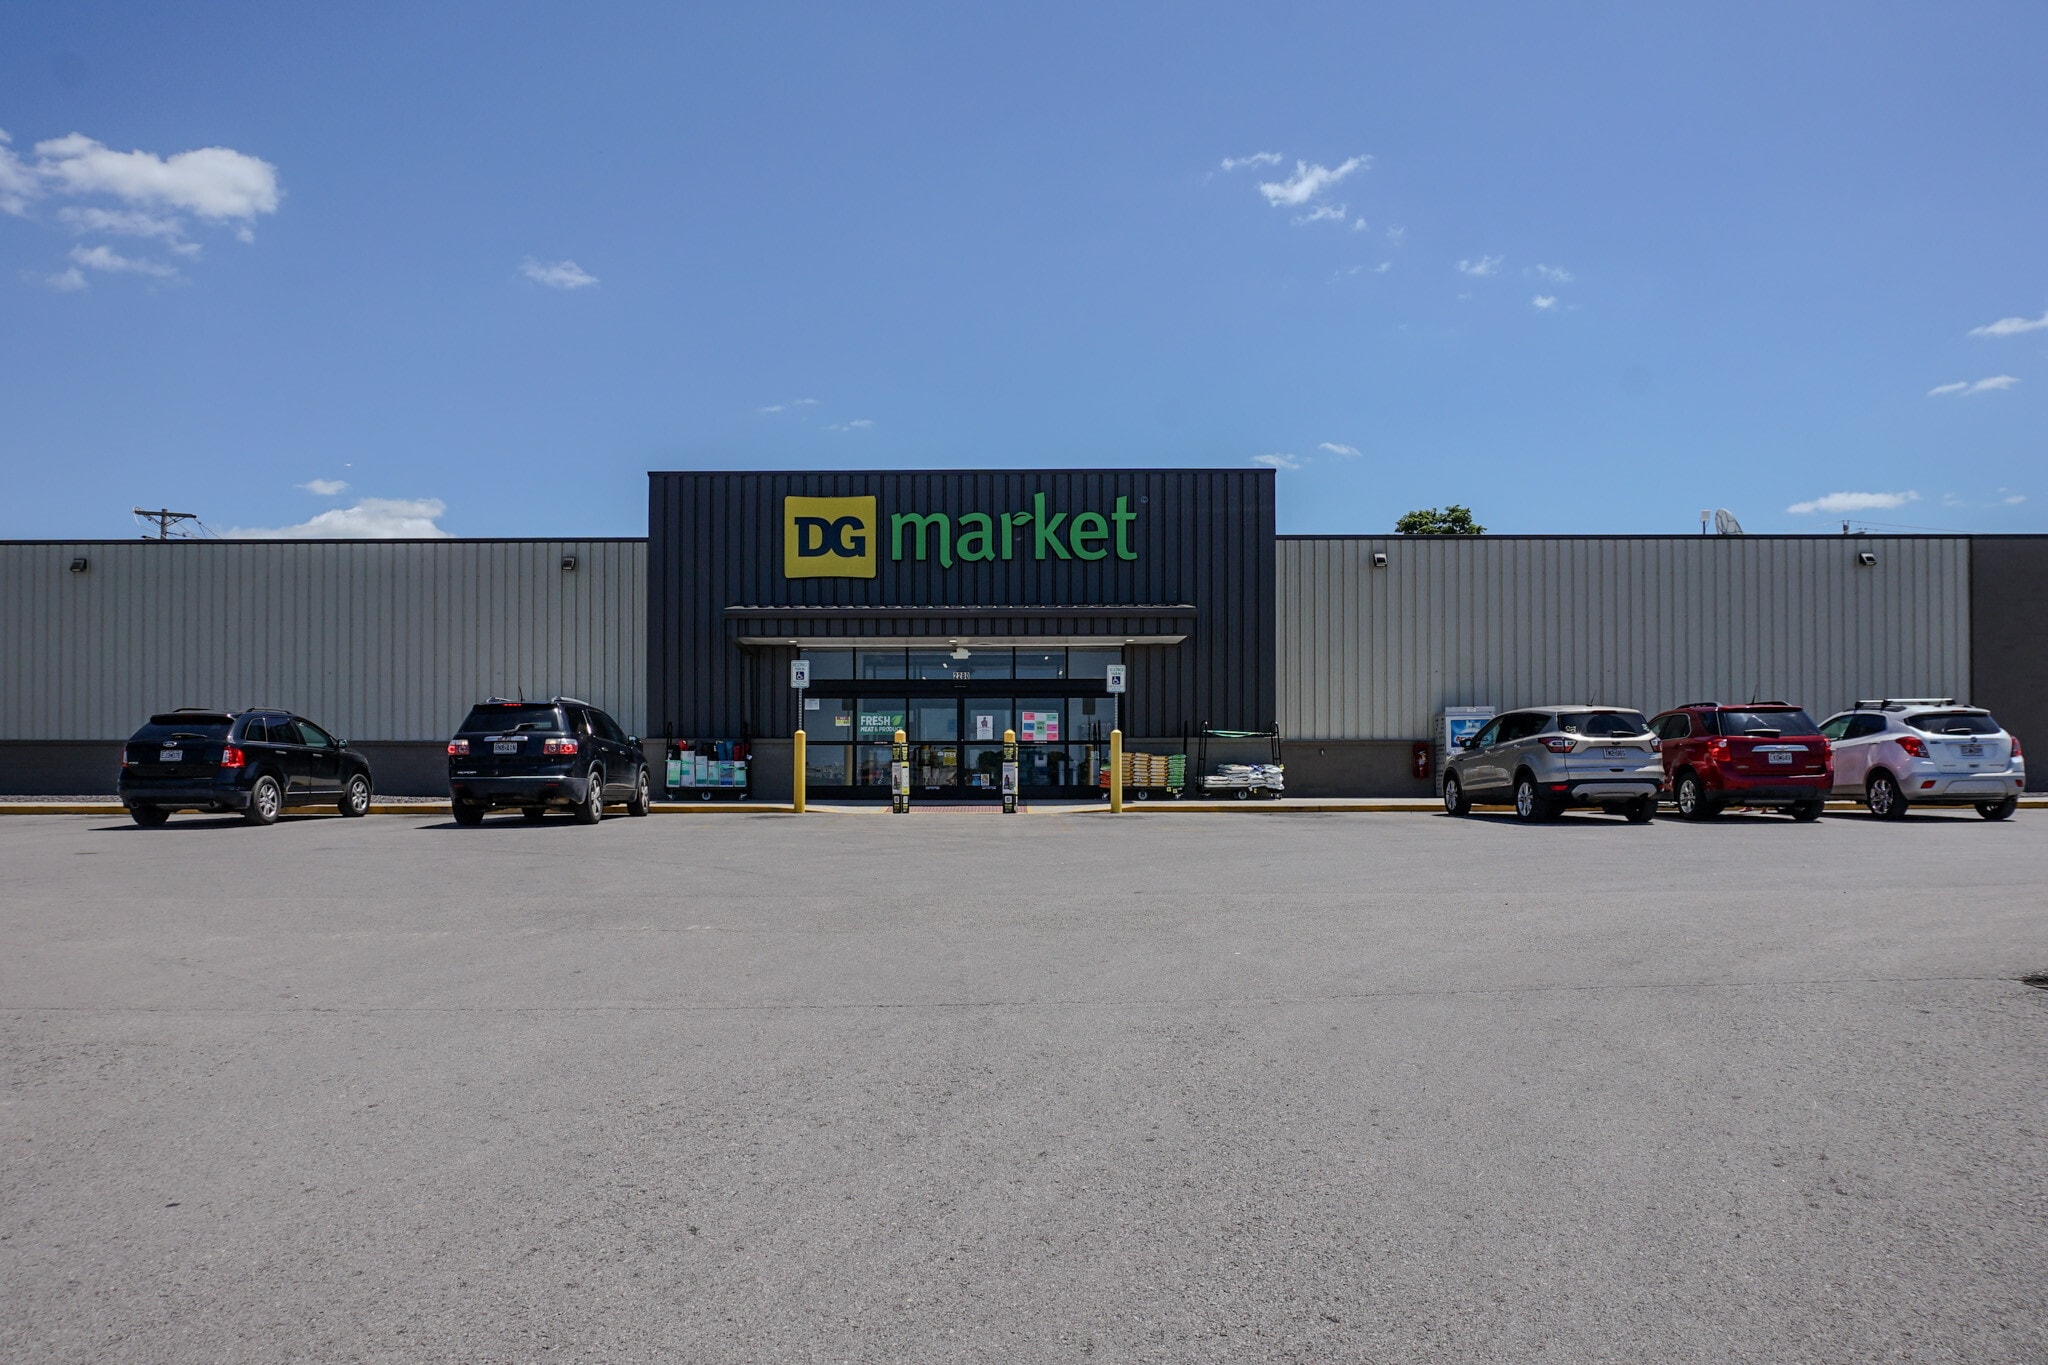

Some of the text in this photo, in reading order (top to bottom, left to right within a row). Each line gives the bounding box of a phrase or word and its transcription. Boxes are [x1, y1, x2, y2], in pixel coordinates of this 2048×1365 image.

[794, 515, 866, 558] DG
[891, 492, 1138, 570] market
[860, 715, 891, 726] FRESH
